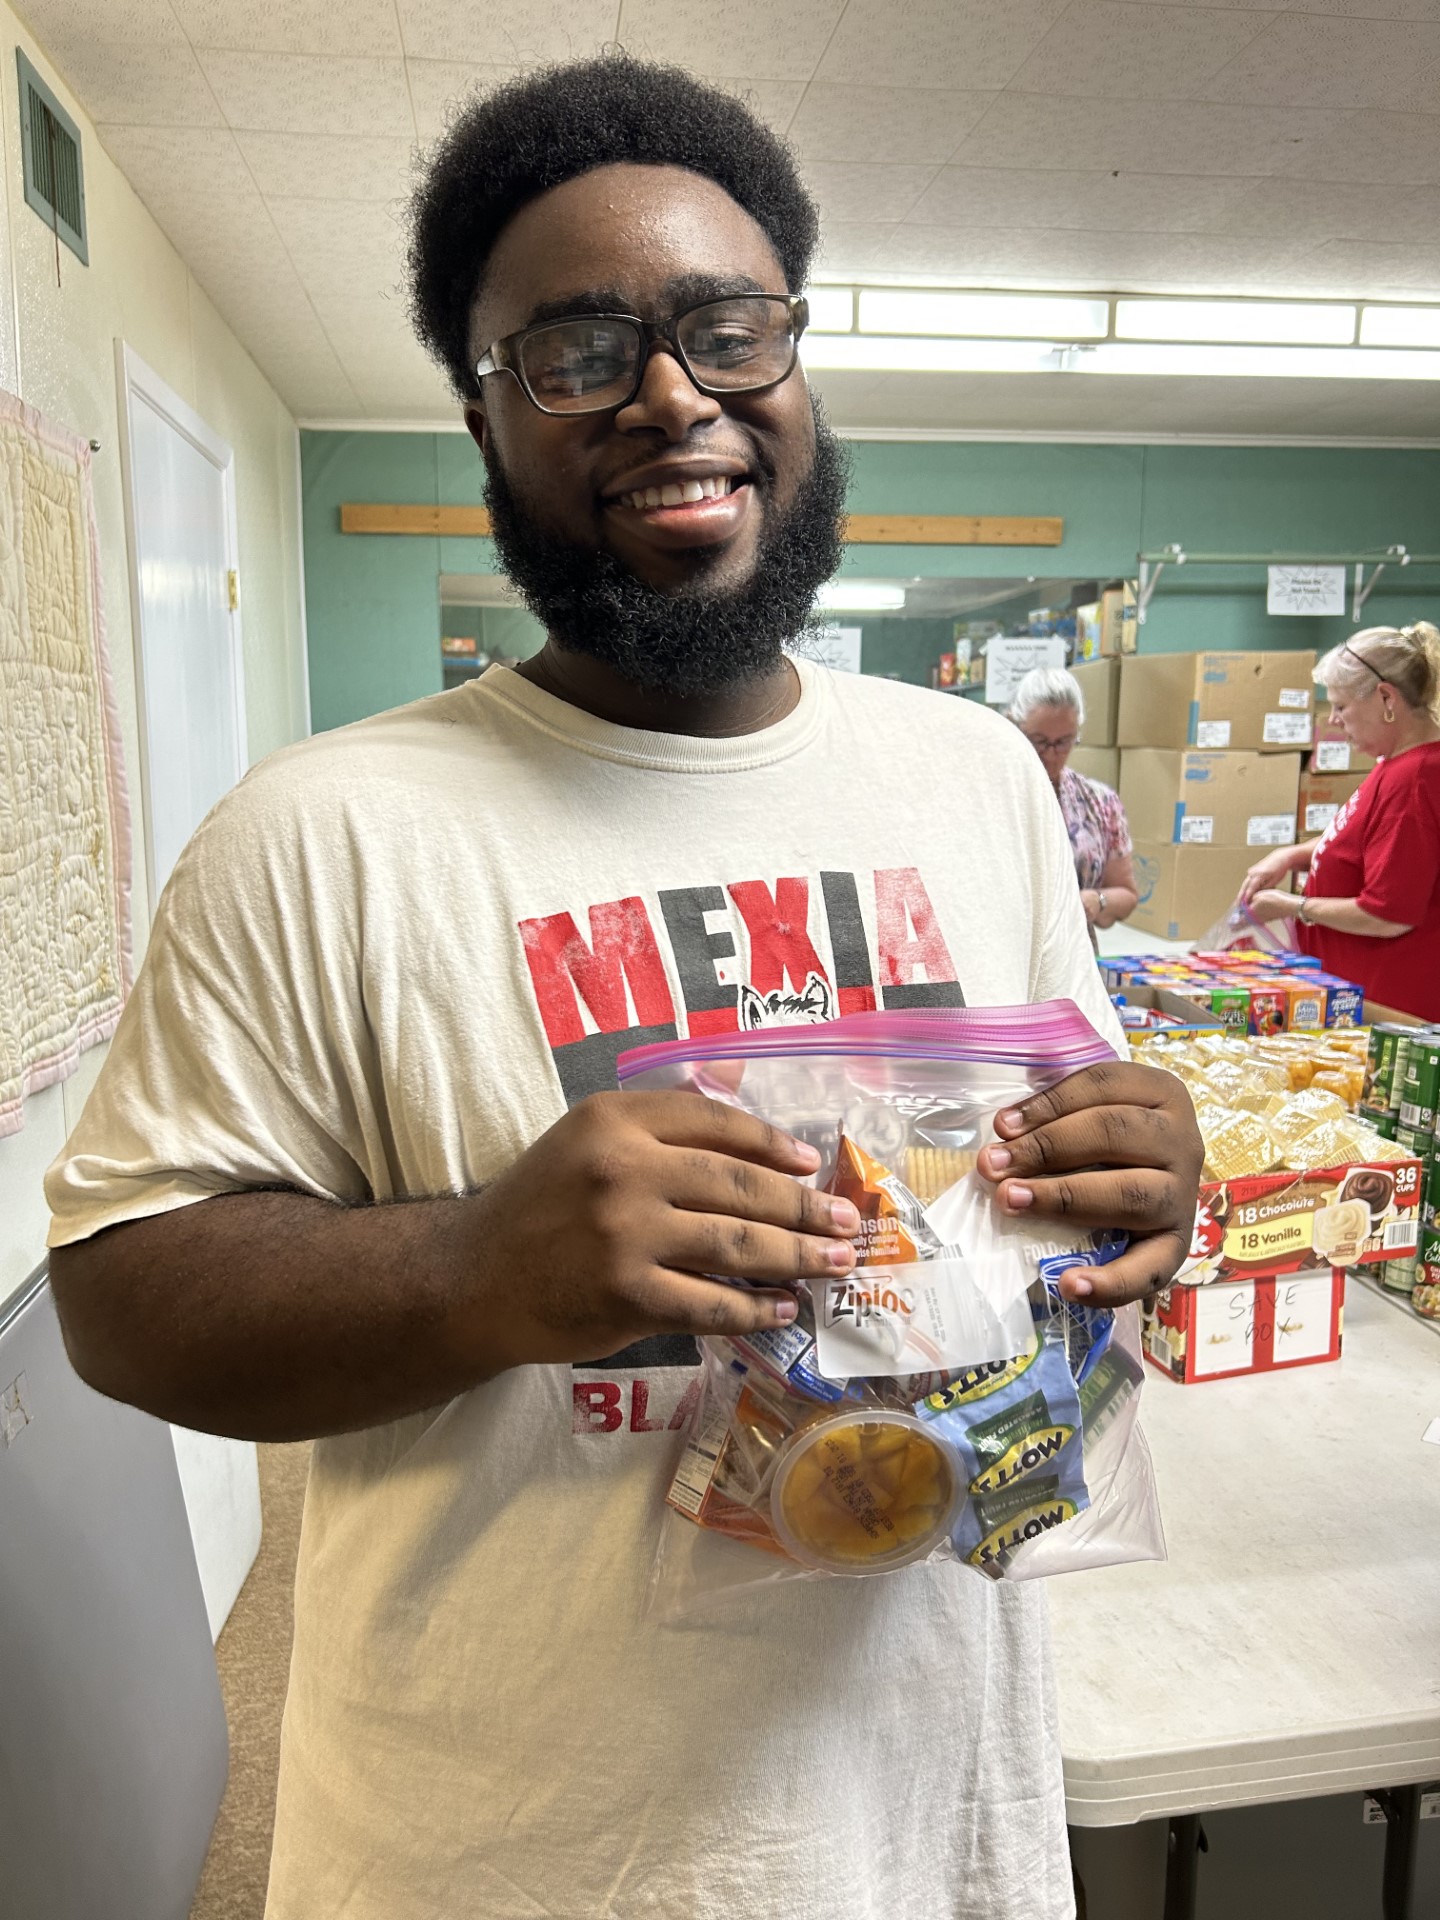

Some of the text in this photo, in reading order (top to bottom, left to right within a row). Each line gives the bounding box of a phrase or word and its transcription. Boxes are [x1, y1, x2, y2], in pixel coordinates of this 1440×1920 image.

[518, 867, 963, 1048] MEXIA
[1395, 1166, 1417, 1184] 36
[1396, 1182, 1415, 1193] CUPS
[1237, 1197, 1315, 1226] 18 Chocolate
[859, 1217, 898, 1234] nson
[1240, 1232, 1259, 1250] 18
[1260, 1226, 1302, 1246] Vanilla
[1022, 1240, 1057, 1266] FOLD
[830, 1283, 917, 1327] Ziploc
[1229, 1283, 1302, 1320] SAVE
[1245, 1317, 1292, 1347] BOX
